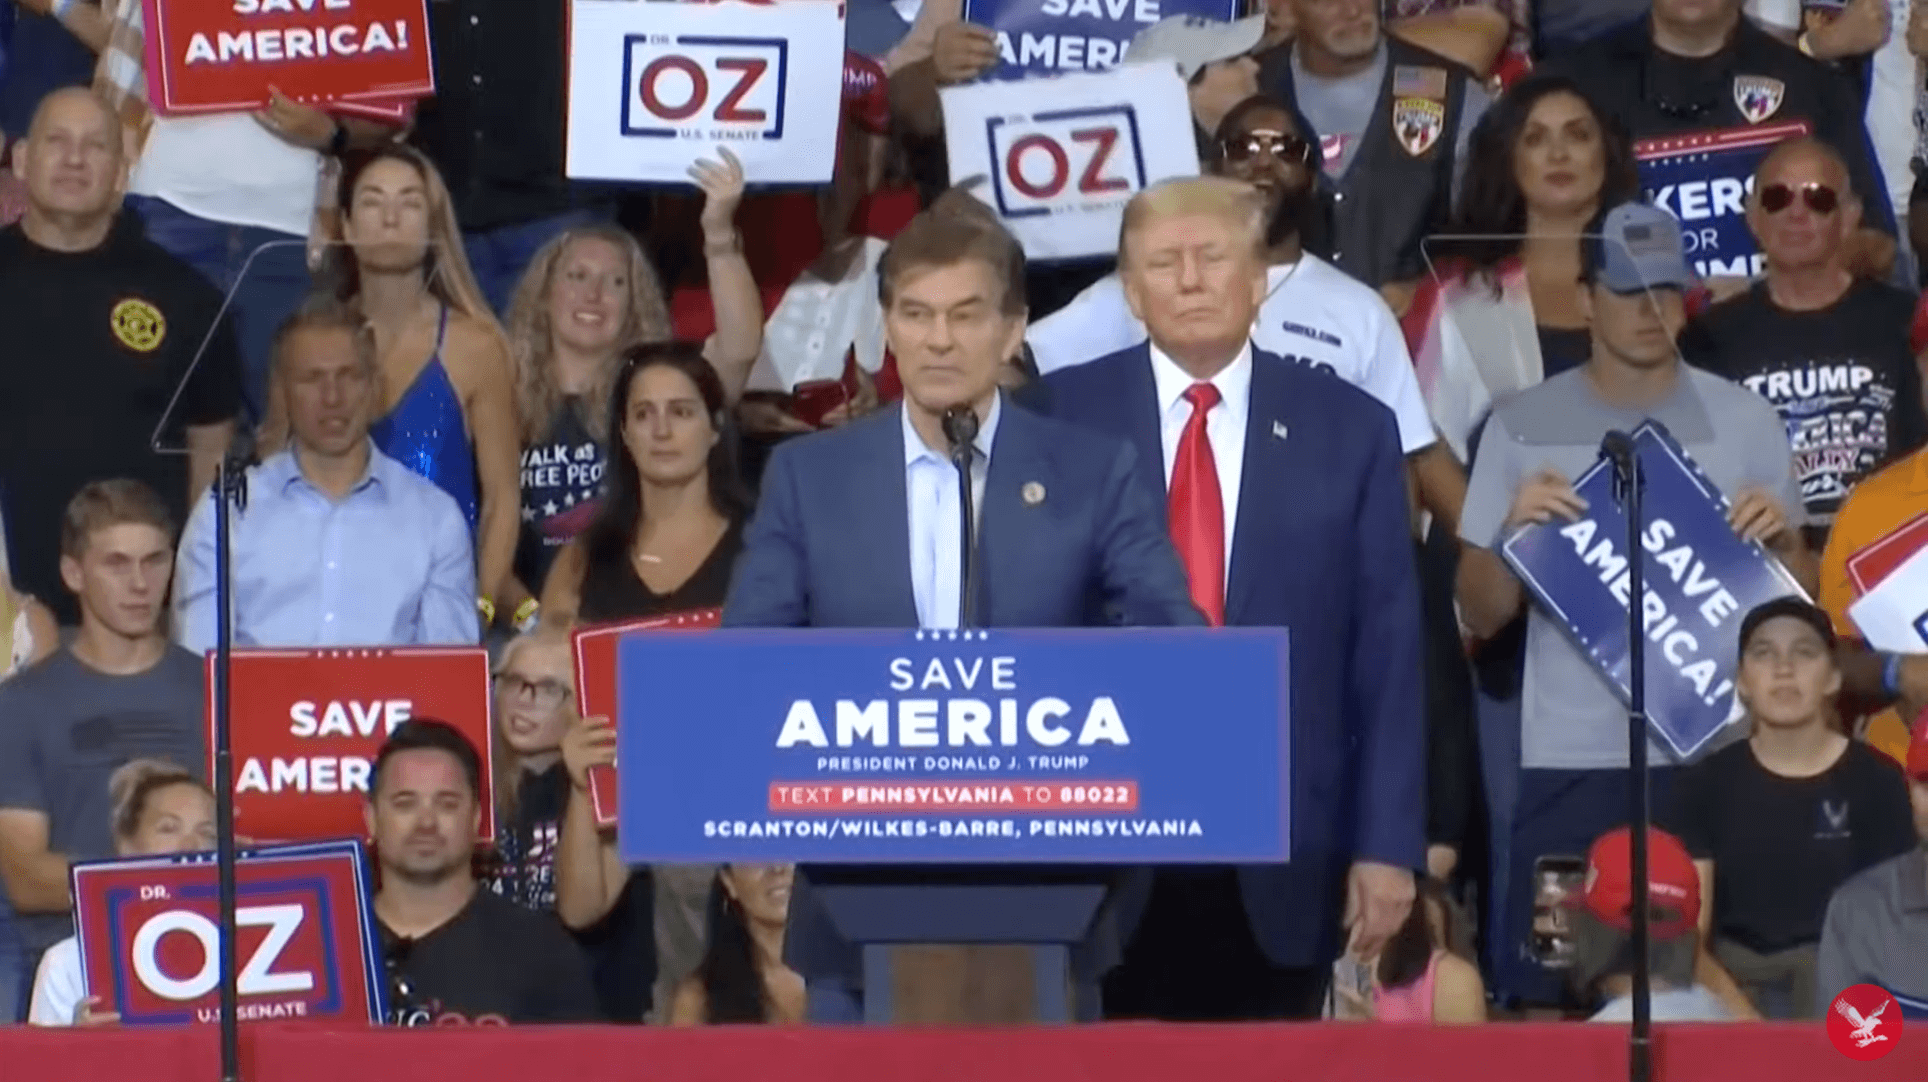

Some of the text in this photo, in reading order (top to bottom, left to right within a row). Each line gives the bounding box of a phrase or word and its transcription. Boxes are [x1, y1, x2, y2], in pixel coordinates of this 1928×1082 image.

[185, 20, 408, 64] AMERICA!
[995, 31, 1130, 68] AMERI
[639, 54, 768, 121] OZ
[709, 130, 760, 141] SENATE
[1006, 126, 1130, 199] OZ
[1743, 364, 1874, 399] TRUMP
[1640, 517, 1739, 628] SAVE
[890, 656, 1016, 691] SAVE
[289, 699, 413, 737] SAVE
[775, 697, 1130, 748] AMERICA
[235, 756, 371, 794] AMER
[817, 755, 1090, 771] PRESIDENT DONALD J. TRUMP
[777, 786, 1130, 804] TEXT PENNSYLVANIA TO 88022
[703, 818, 1203, 839] SCRANTON/WILKES-BARRE, PENNSYLVANIA
[140, 884, 171, 900] DR.
[132, 904, 313, 1000] OZ
[236, 1000, 306, 1022] SENATE
